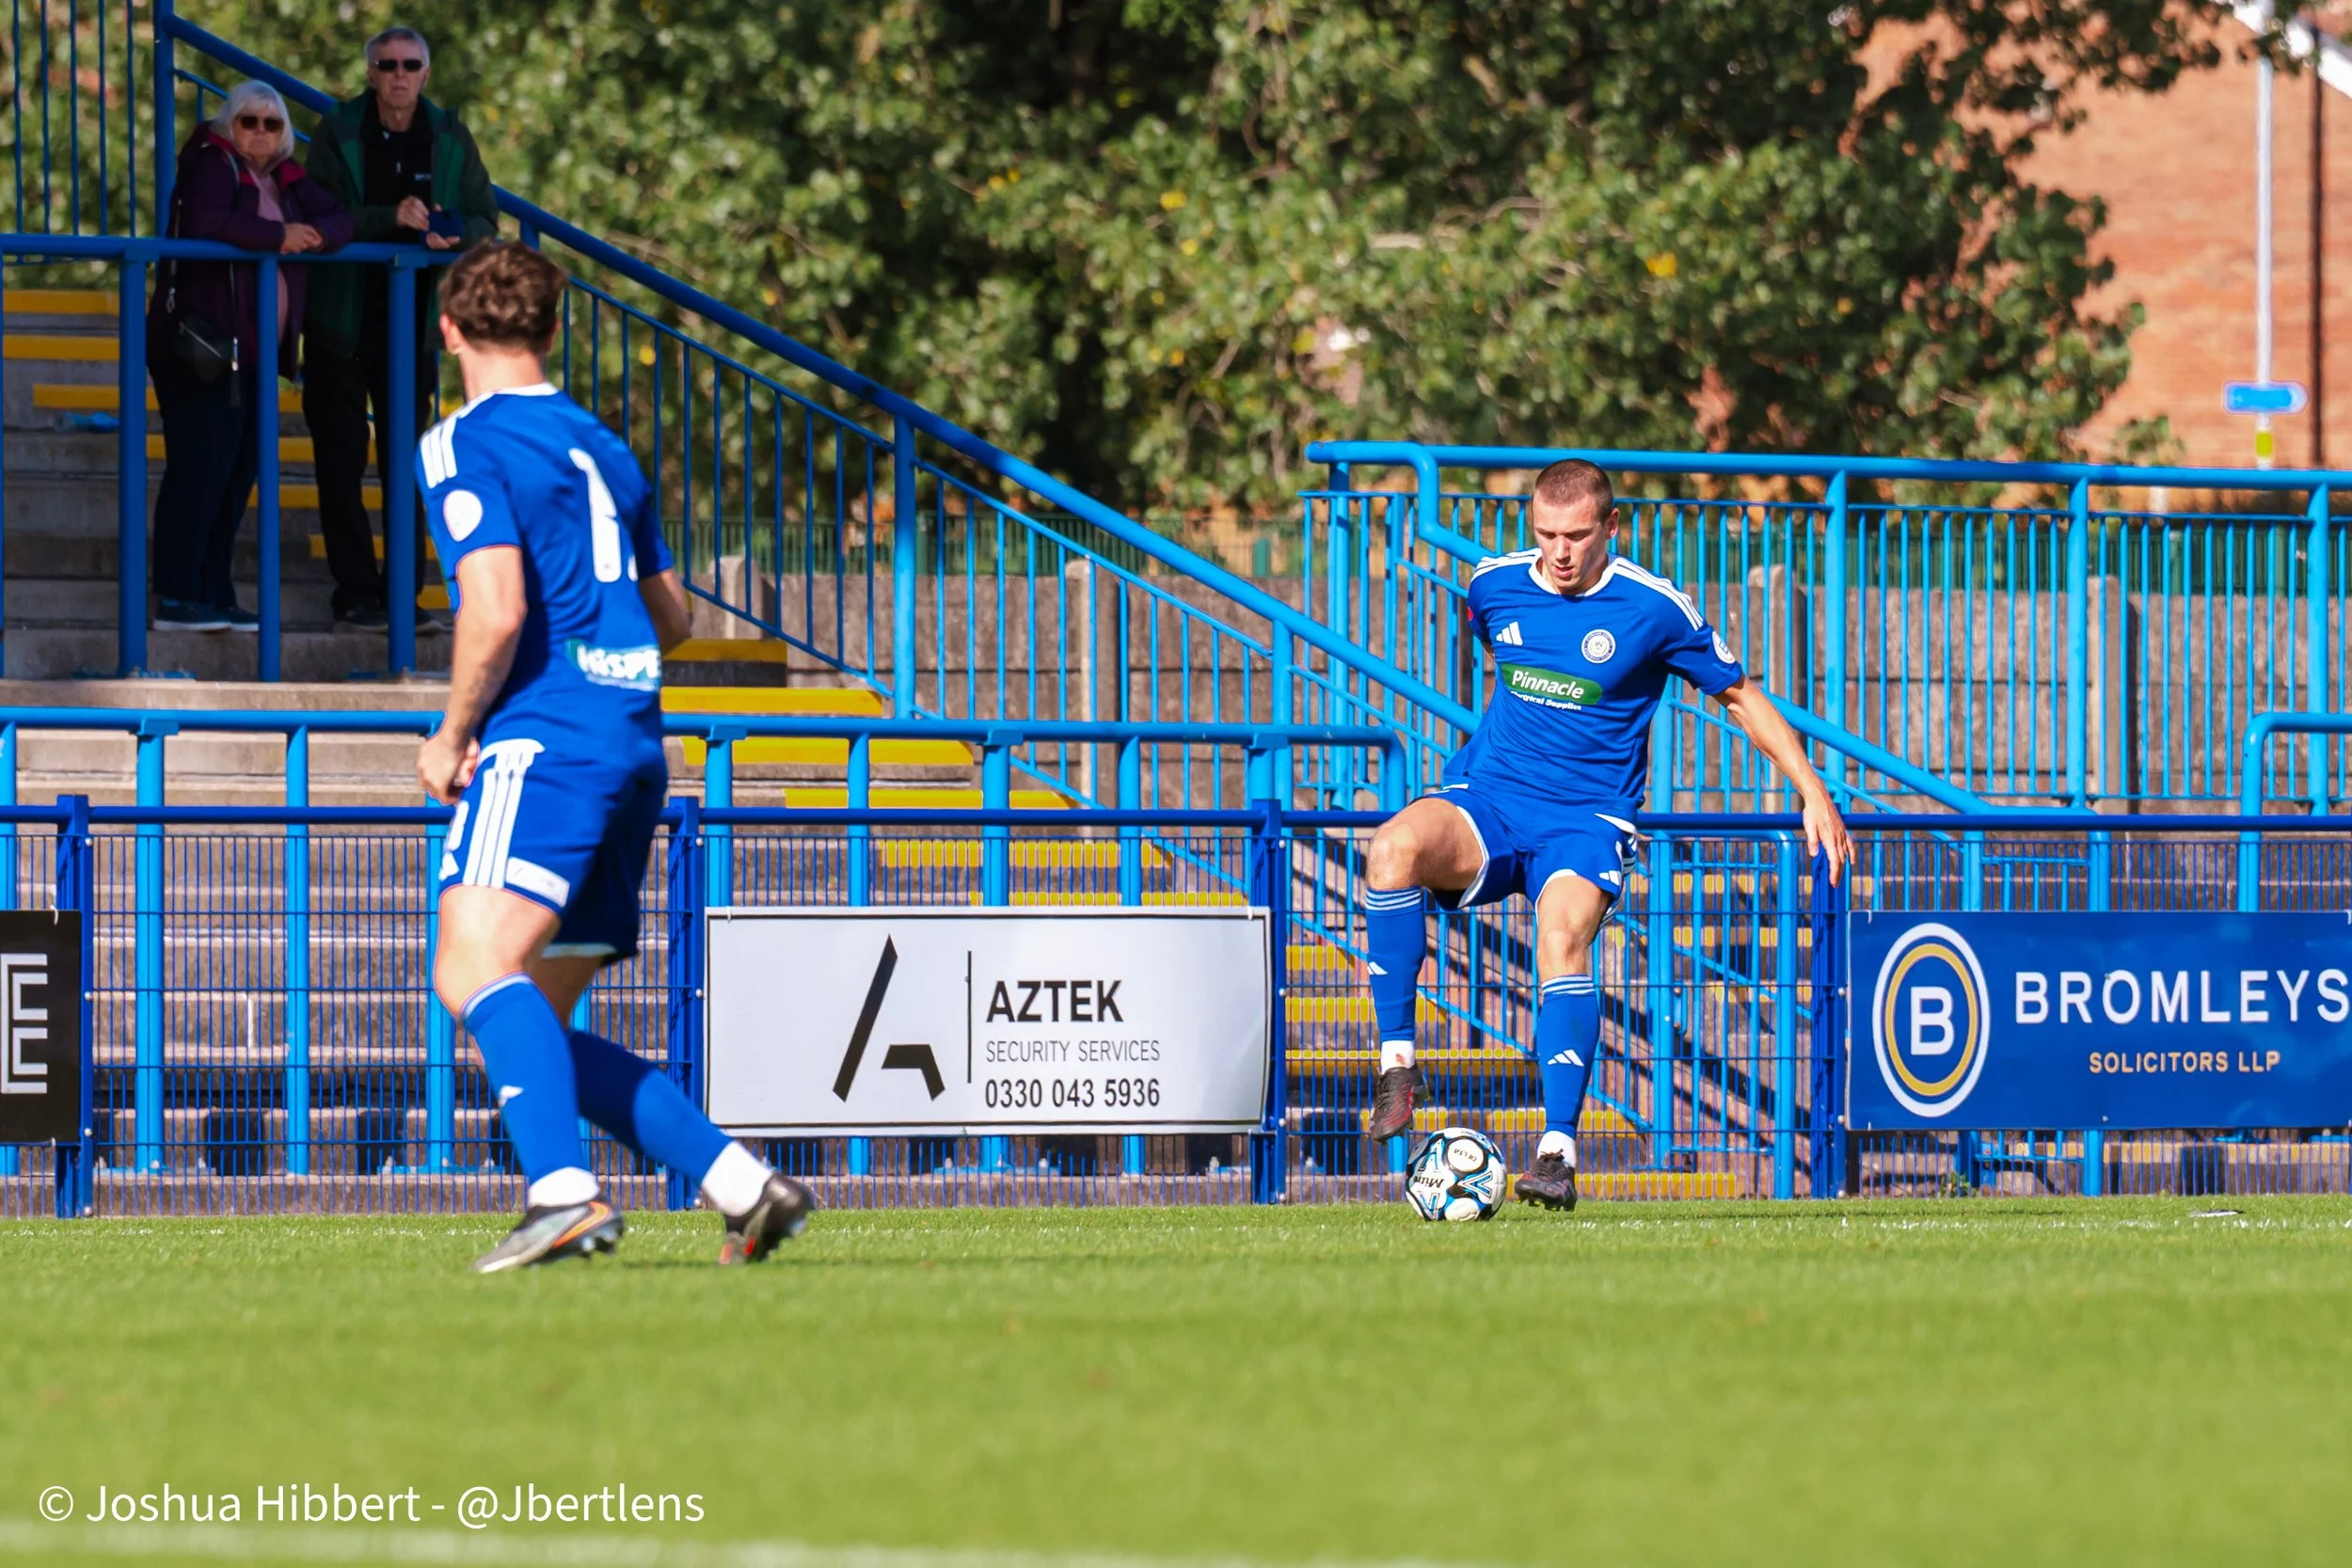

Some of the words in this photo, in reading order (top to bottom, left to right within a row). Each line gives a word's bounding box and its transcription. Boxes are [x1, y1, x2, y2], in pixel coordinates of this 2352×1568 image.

[568, 448, 638, 582] 1
[1512, 670, 1584, 699] Pinnacle
[1545, 699, 1581, 710] Supplies
[986, 980, 1124, 1022] AZTEK
[2015, 969, 2349, 1023] BROMLEYS
[1911, 987, 1954, 1055] B
[986, 1040, 1071, 1062] SECURITY
[1078, 1039, 1160, 1062] SERVICES
[2089, 1051, 2228, 1073] SOLICITORS
[2239, 1051, 2280, 1072] LLP
[985, 1079, 1042, 1108] 0330
[1052, 1079, 1094, 1107] 043
[1104, 1078, 1160, 1107] 5936
